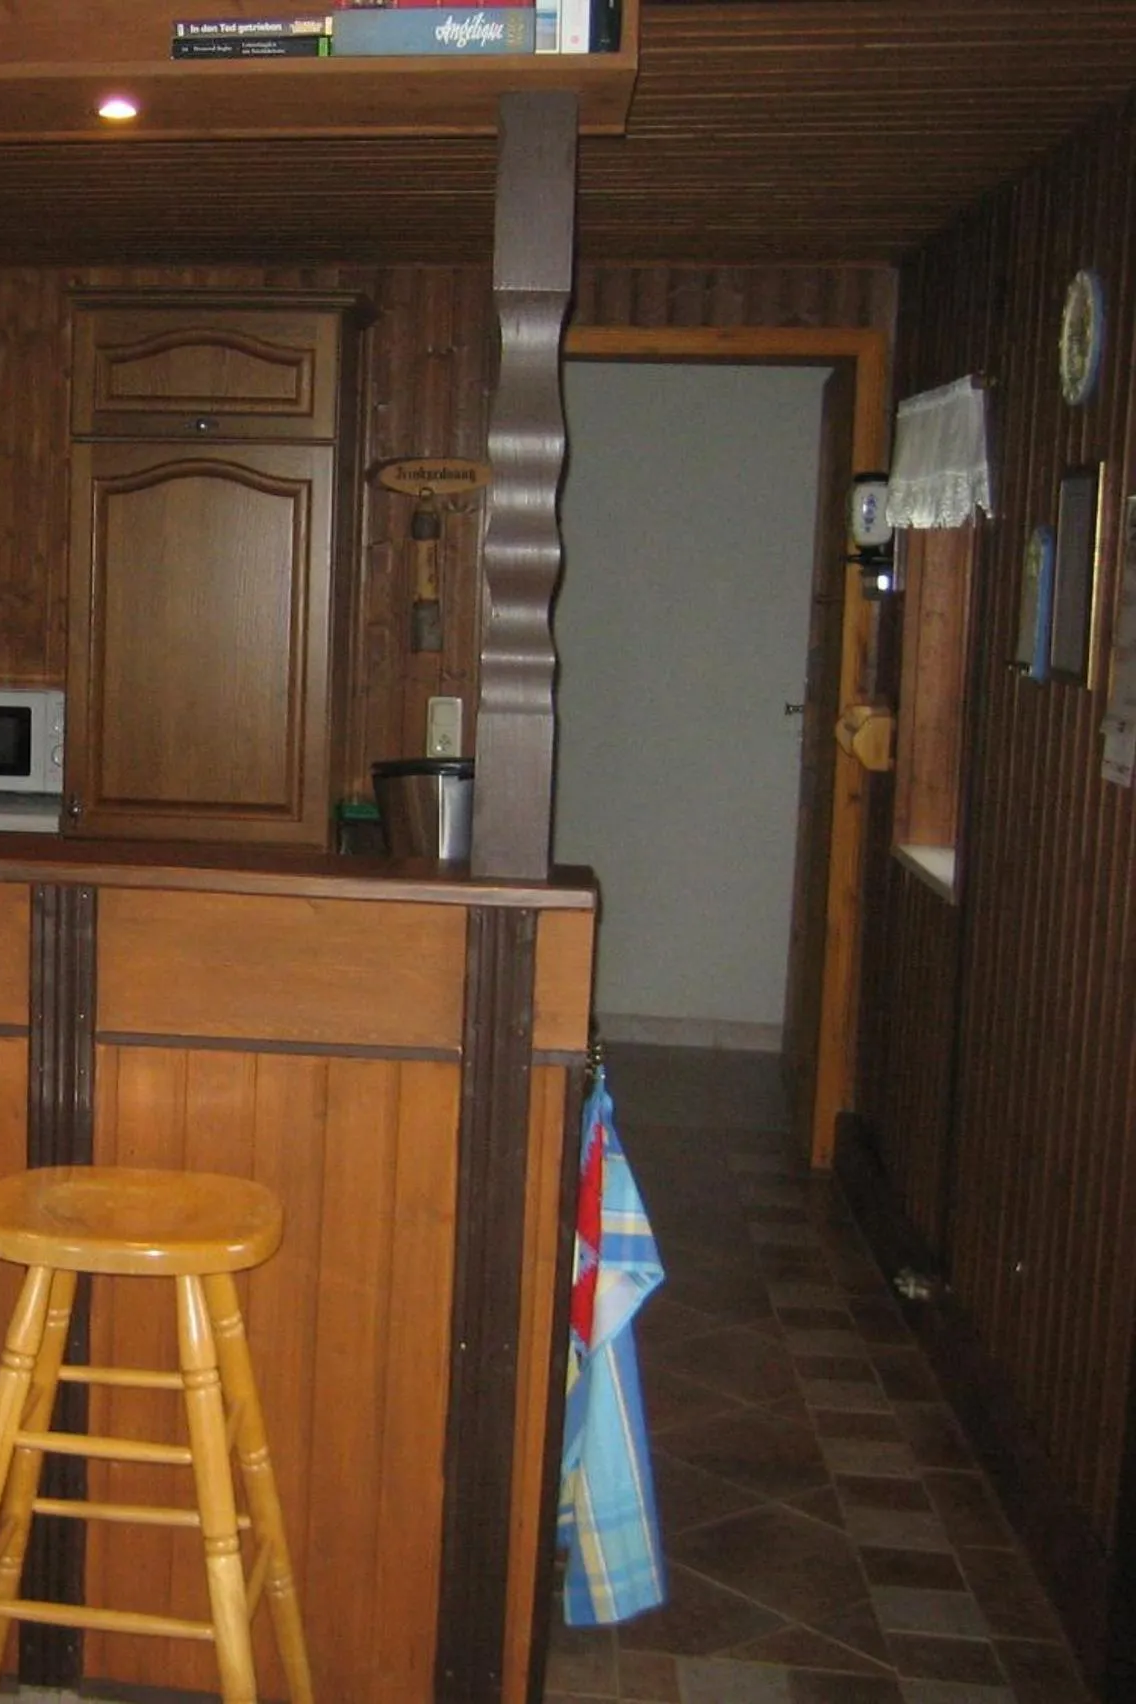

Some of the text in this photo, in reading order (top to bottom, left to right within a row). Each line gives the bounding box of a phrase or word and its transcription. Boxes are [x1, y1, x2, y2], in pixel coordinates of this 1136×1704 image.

[190, 24, 199, 34] In
[219, 23, 237, 33] Tod
[238, 22, 282, 35] getrieben
